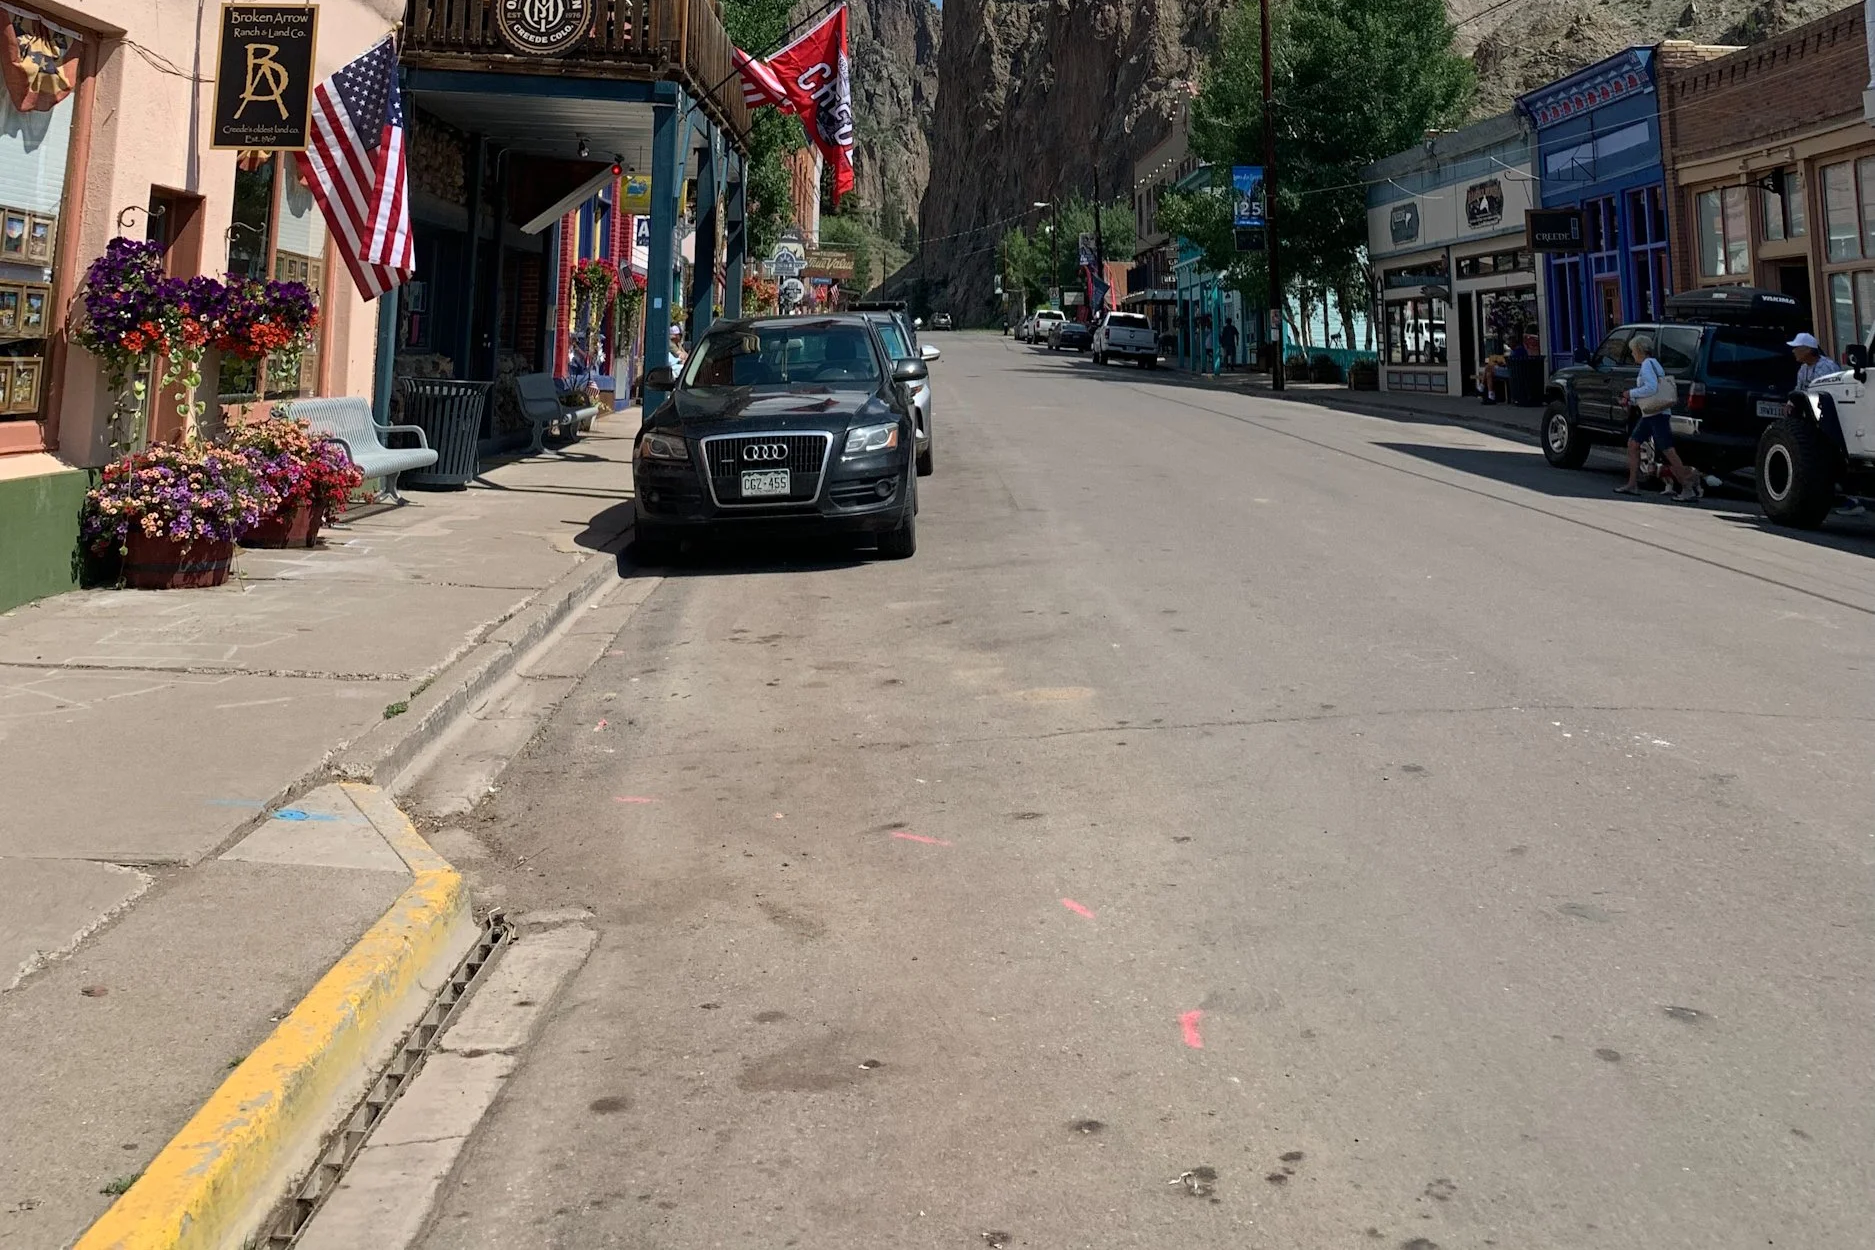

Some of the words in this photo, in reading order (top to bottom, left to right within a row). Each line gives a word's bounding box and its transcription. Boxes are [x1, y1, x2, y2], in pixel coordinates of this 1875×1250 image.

[231, 9, 273, 24] Broken
[273, 12, 309, 24] Arrow
[233, 26, 260, 38] Ranch
[268, 27, 290, 38] Land
[290, 28, 307, 39] Co.
[513, 24, 548, 43] CREEDE
[550, 24, 574, 42] COLO.
[222, 124, 253, 134] Creede's
[253, 124, 274, 134] oldest
[274, 124, 289, 134] land
[1233, 201, 1261, 216] 125
[1535, 232, 1571, 243] CREEDE
[822, 257, 855, 270] Value
[1762, 295, 1796, 305] YAKIMA
